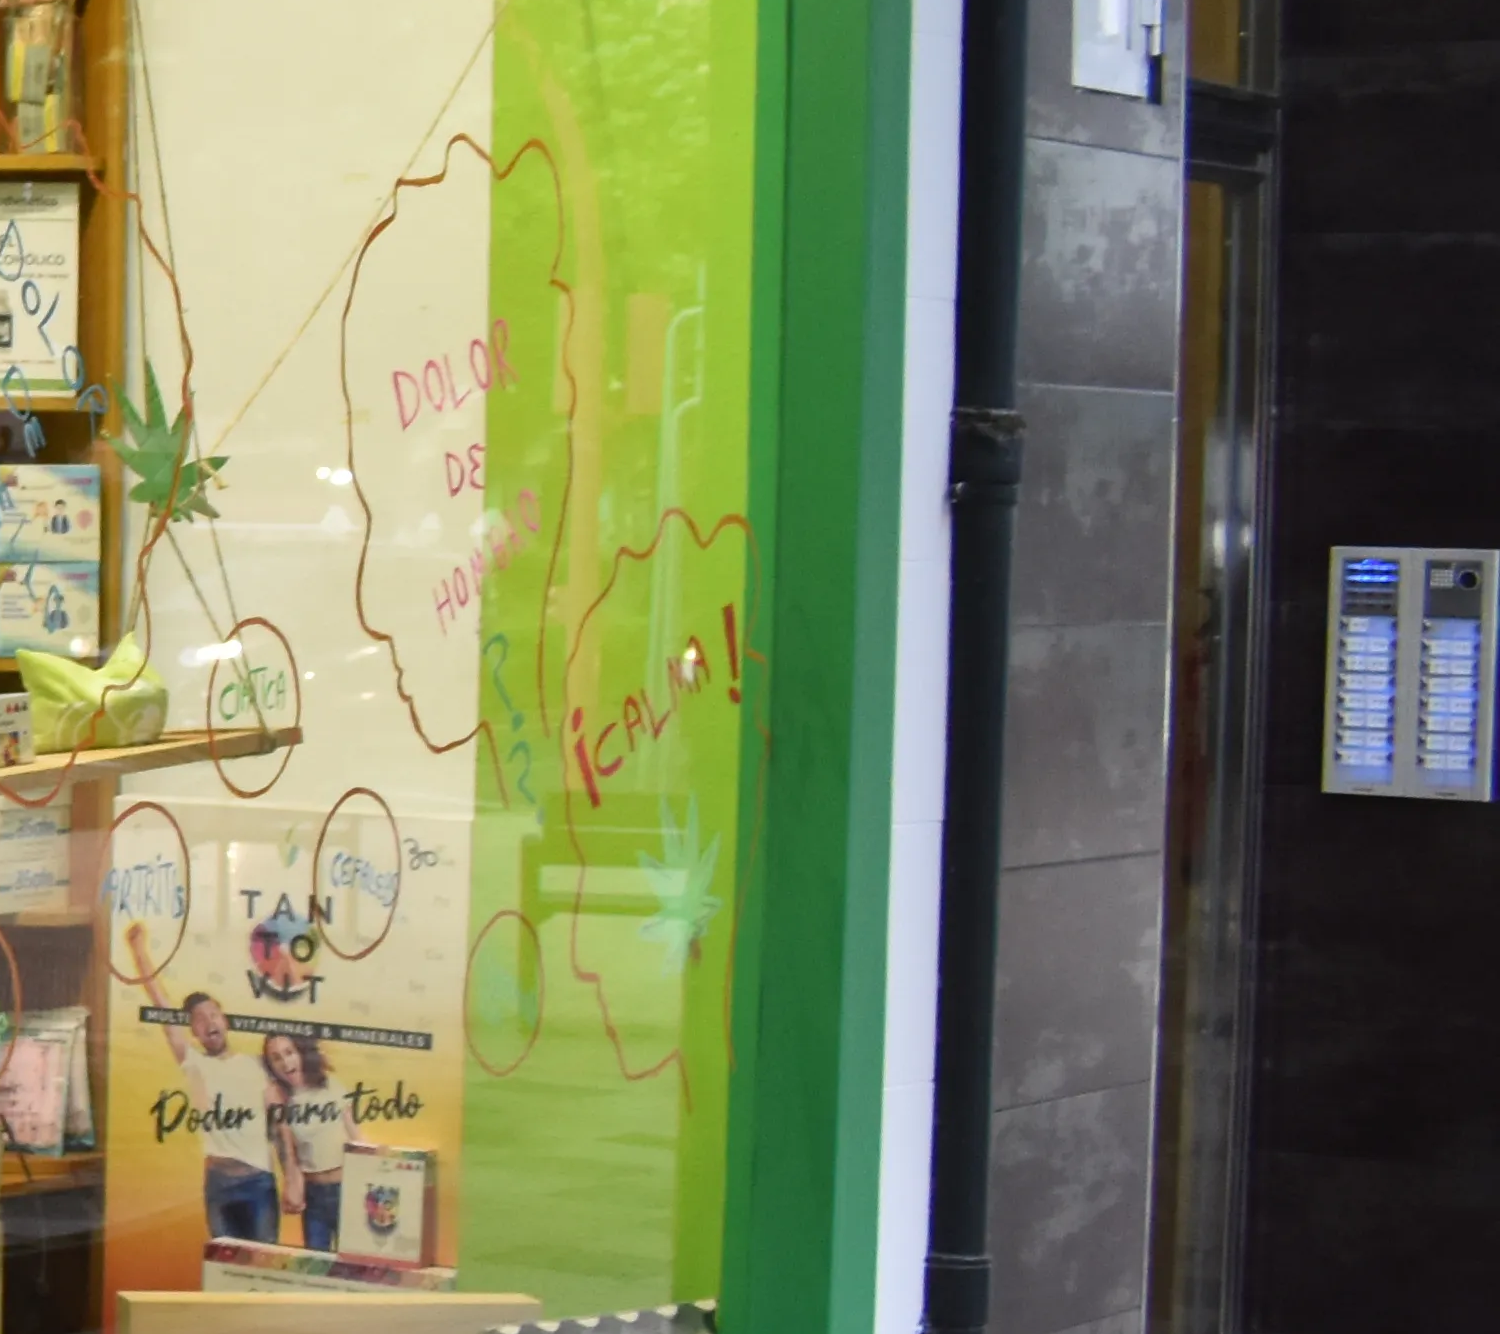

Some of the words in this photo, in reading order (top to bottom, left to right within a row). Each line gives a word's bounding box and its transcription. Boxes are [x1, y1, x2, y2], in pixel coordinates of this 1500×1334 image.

[392, 318, 520, 430] DOLOR
[445, 443, 486, 498] DE
[149, 1088, 256, 1143] Poder
[264, 1099, 341, 1141] para
[343, 1079, 425, 1125] todo
